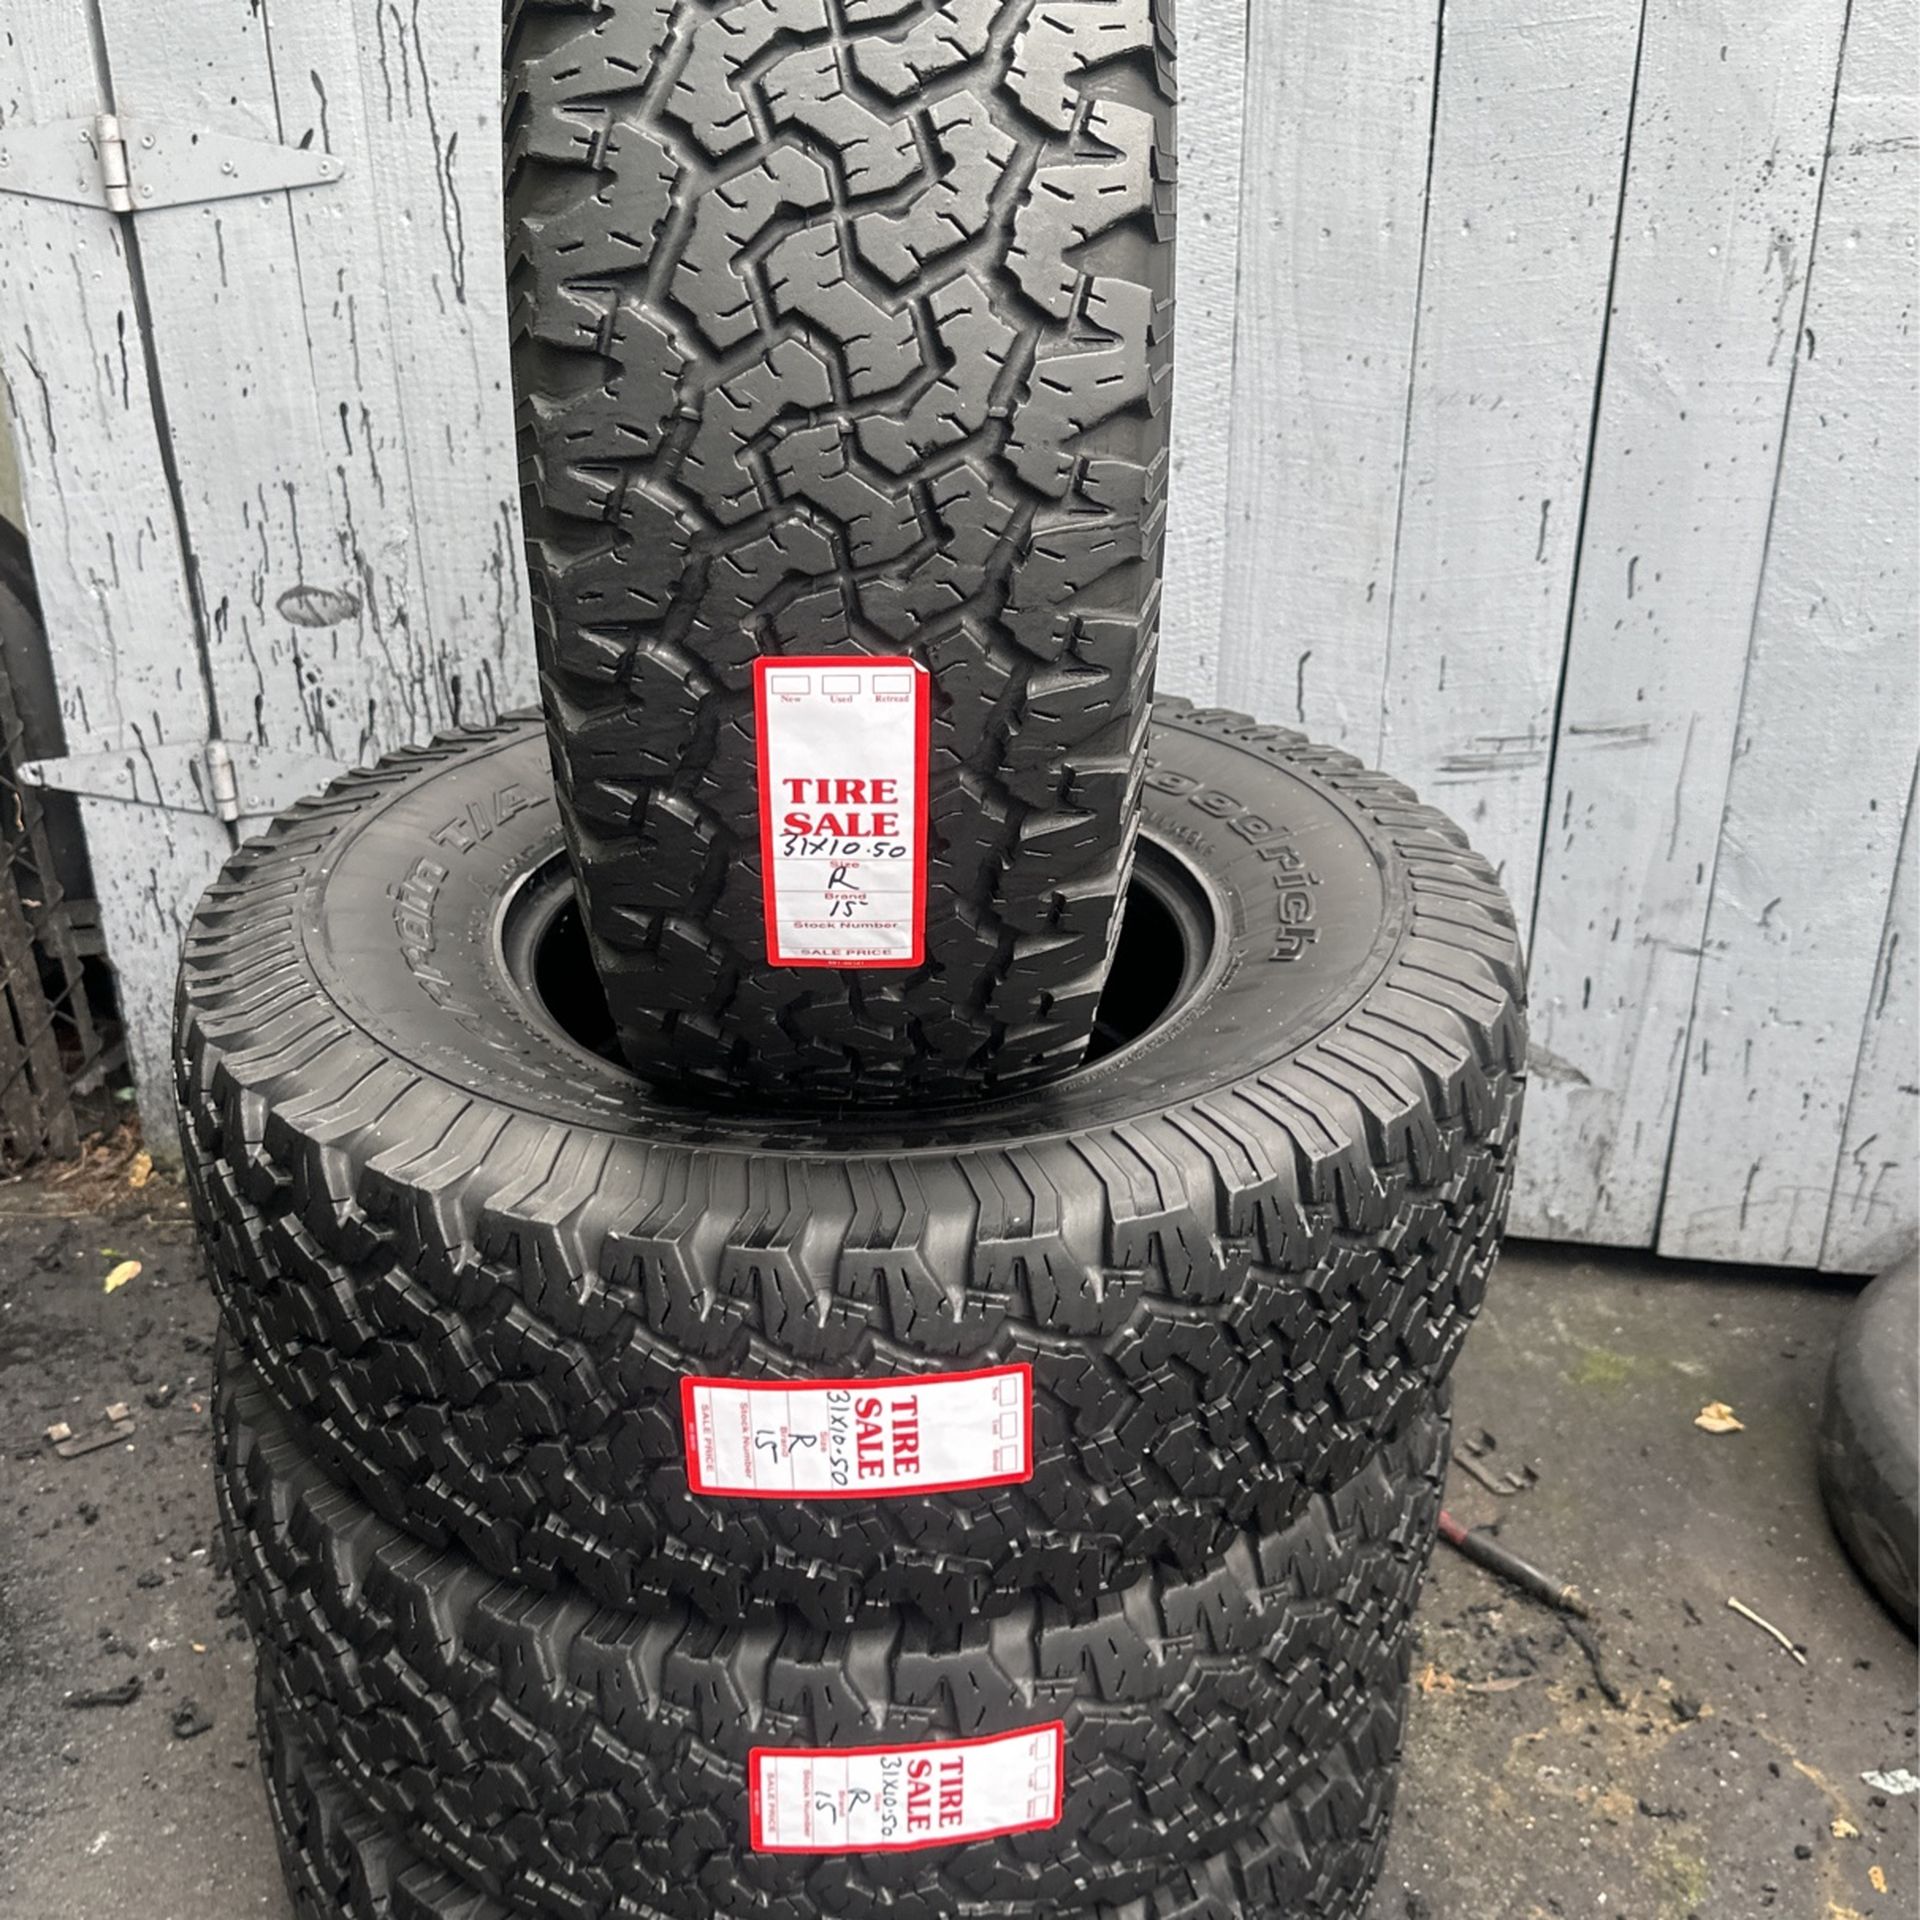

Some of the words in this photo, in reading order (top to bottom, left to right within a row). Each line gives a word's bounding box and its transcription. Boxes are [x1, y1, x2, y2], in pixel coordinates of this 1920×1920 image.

[779, 694, 801, 703] New
[829, 694, 854, 703] Used
[874, 694, 910, 703] Retread
[782, 778, 898, 804] TIRE
[783, 812, 900, 837] SALE
[827, 866, 860, 890] R
[829, 860, 860, 869] Size
[824, 892, 867, 900] Brand
[829, 900, 869, 917] 15
[793, 921, 836, 929] Stock
[839, 921, 899, 929] Number
[800, 948, 842, 956] SALE
[845, 948, 893, 956] PRICE
[701, 1404, 711, 1433] SALE
[739, 1402, 750, 1433] Stock
[755, 1429, 778, 1464] 15
[779, 1426, 789, 1458] Brand
[788, 1433, 817, 1453] R
[855, 1397, 885, 1479] SALE
[891, 1394, 920, 1476] TIRE
[704, 1437, 714, 1472] PRICE
[742, 1436, 752, 1479] Number
[847, 1787, 871, 1813] R
[907, 1758, 932, 1833] SALE
[939, 1755, 964, 1828] TIRE
[814, 1790, 837, 1825] 15
